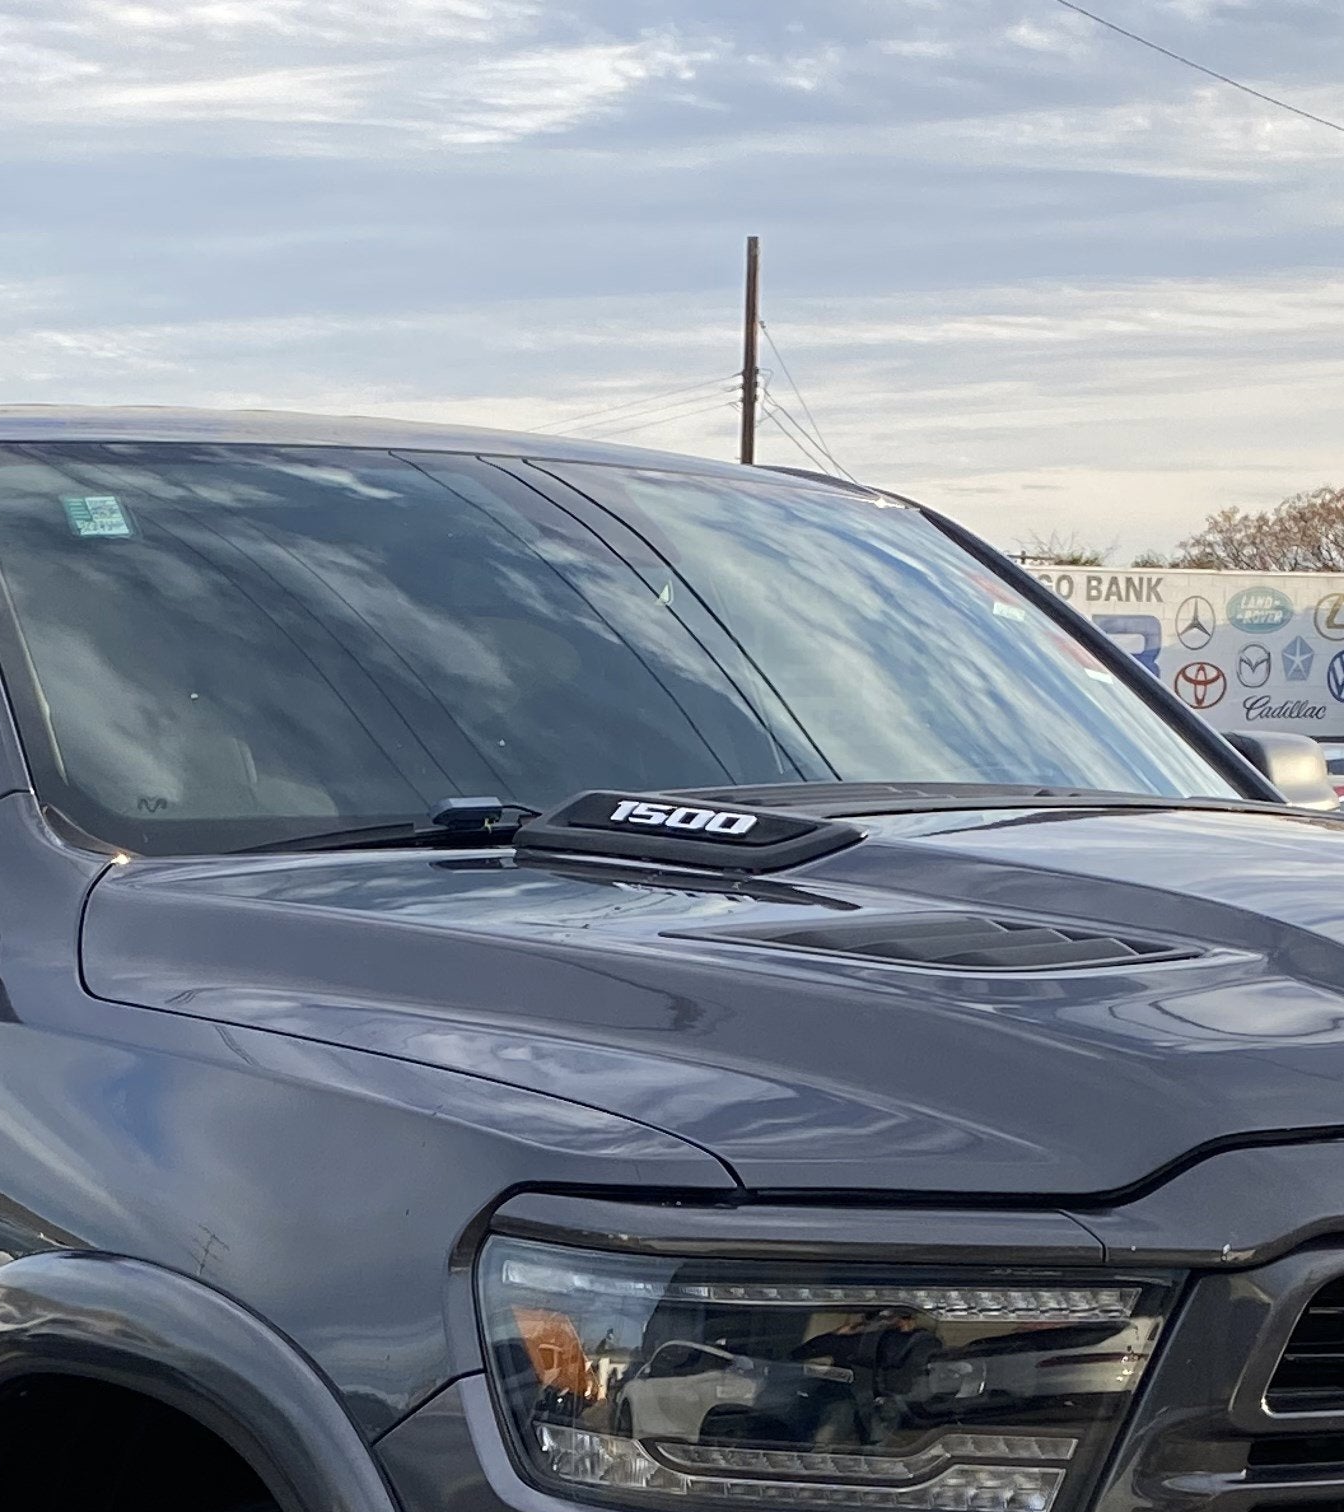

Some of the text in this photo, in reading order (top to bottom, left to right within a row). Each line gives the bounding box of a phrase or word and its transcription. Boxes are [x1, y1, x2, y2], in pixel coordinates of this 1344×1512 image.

[1085, 575, 1164, 603] BANK
[1242, 695, 1327, 721] Cadillac
[610, 800, 757, 834] 1500
